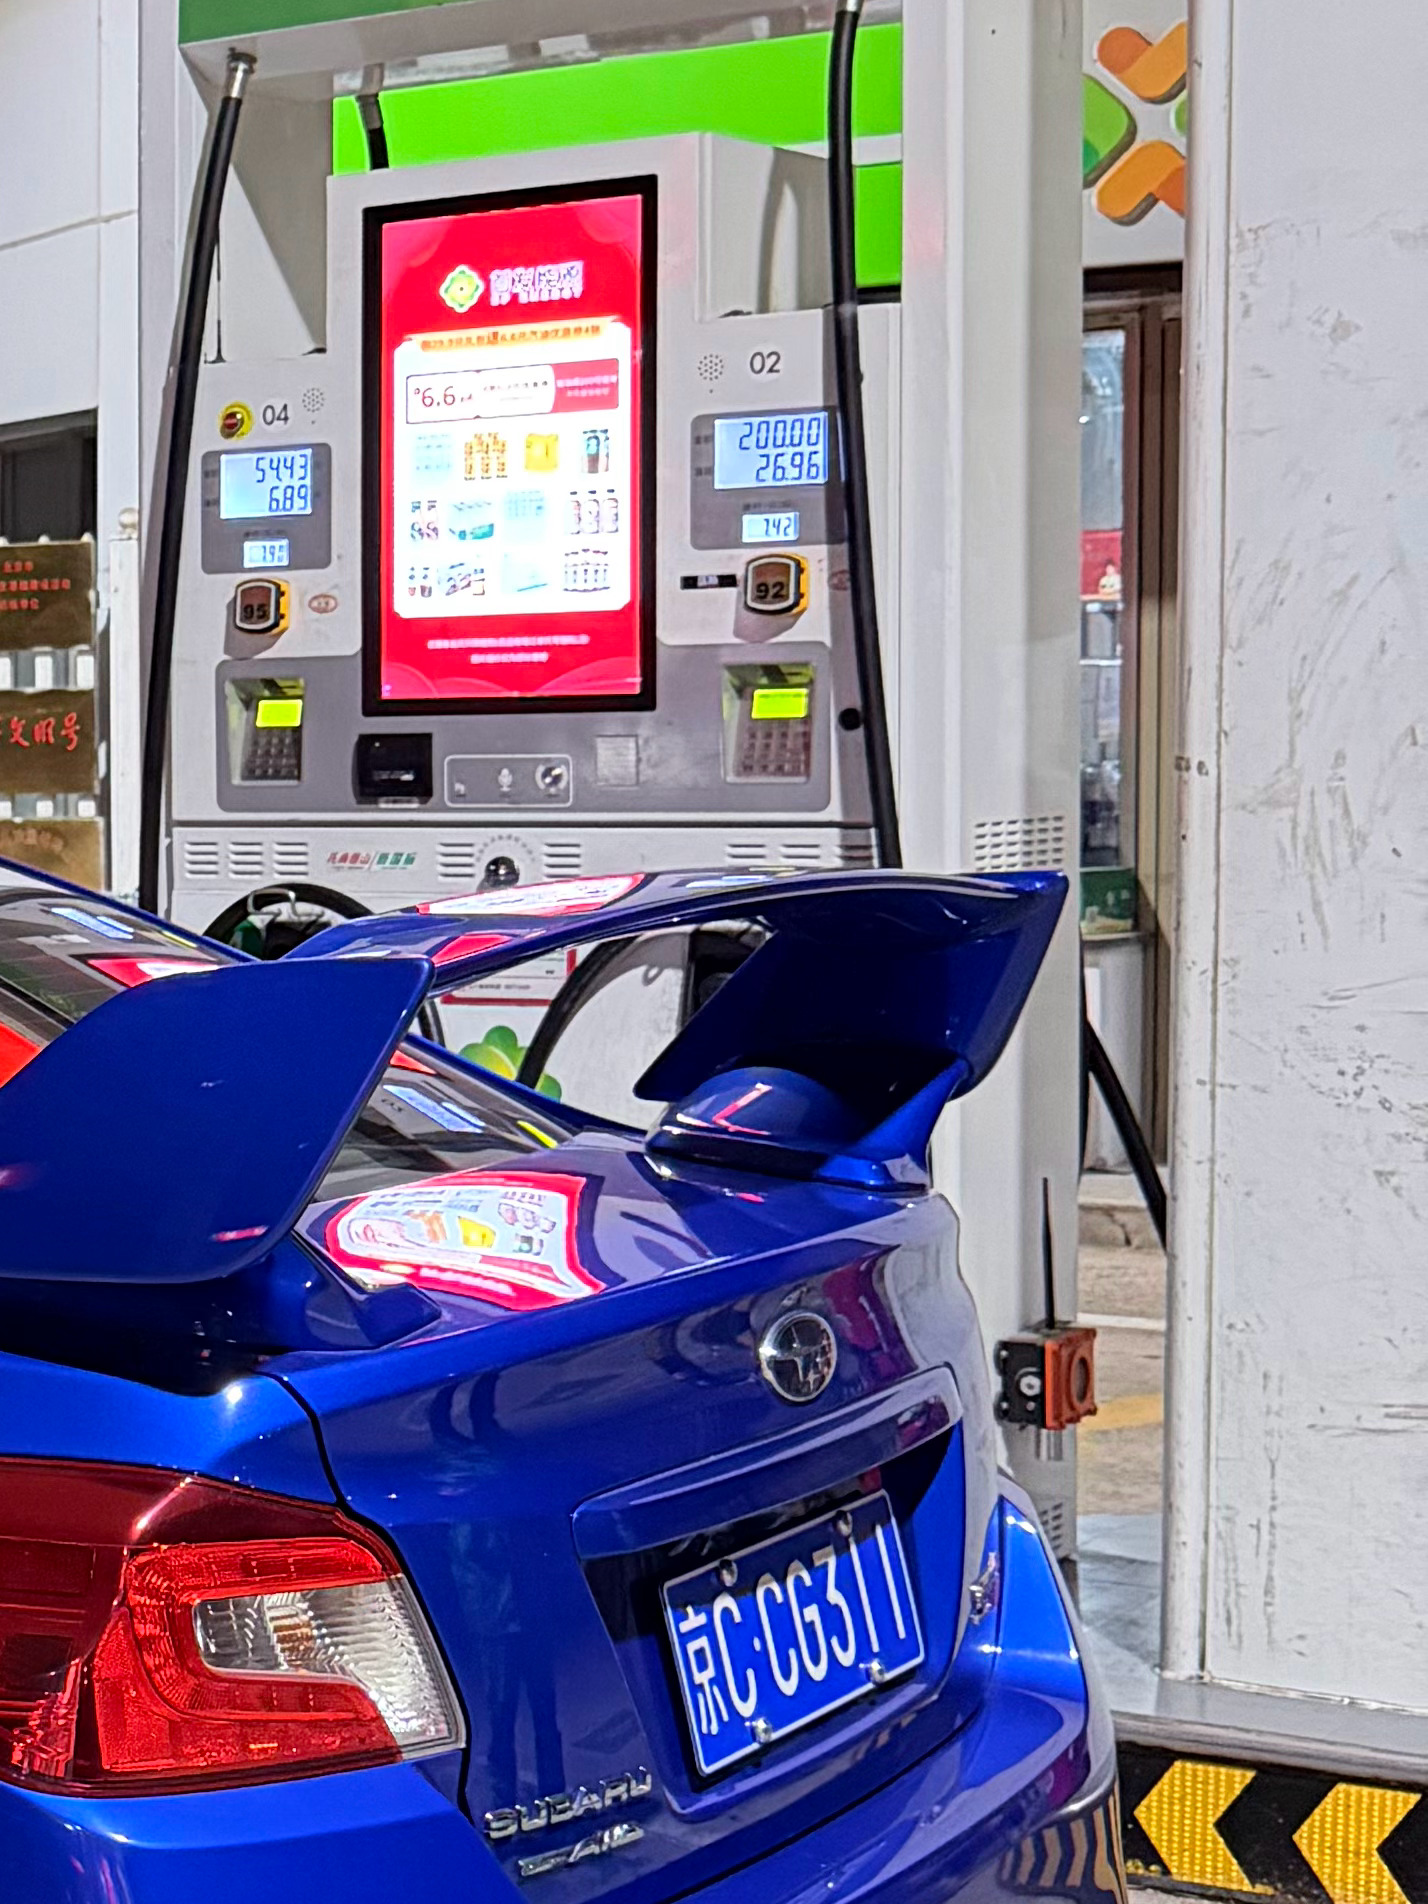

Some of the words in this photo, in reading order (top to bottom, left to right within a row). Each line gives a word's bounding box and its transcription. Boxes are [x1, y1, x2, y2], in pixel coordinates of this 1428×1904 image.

[749, 350, 782, 374] 02
[262, 403, 290, 426] 04
[738, 416, 821, 451] 200.00
[255, 453, 309, 484] 54.43
[755, 450, 820, 483] 26.96
[268, 484, 309, 512] 6.89
[755, 581, 786, 600] 92
[242, 602, 268, 621] 95
[483, 1764, 653, 1840] SUBARU
